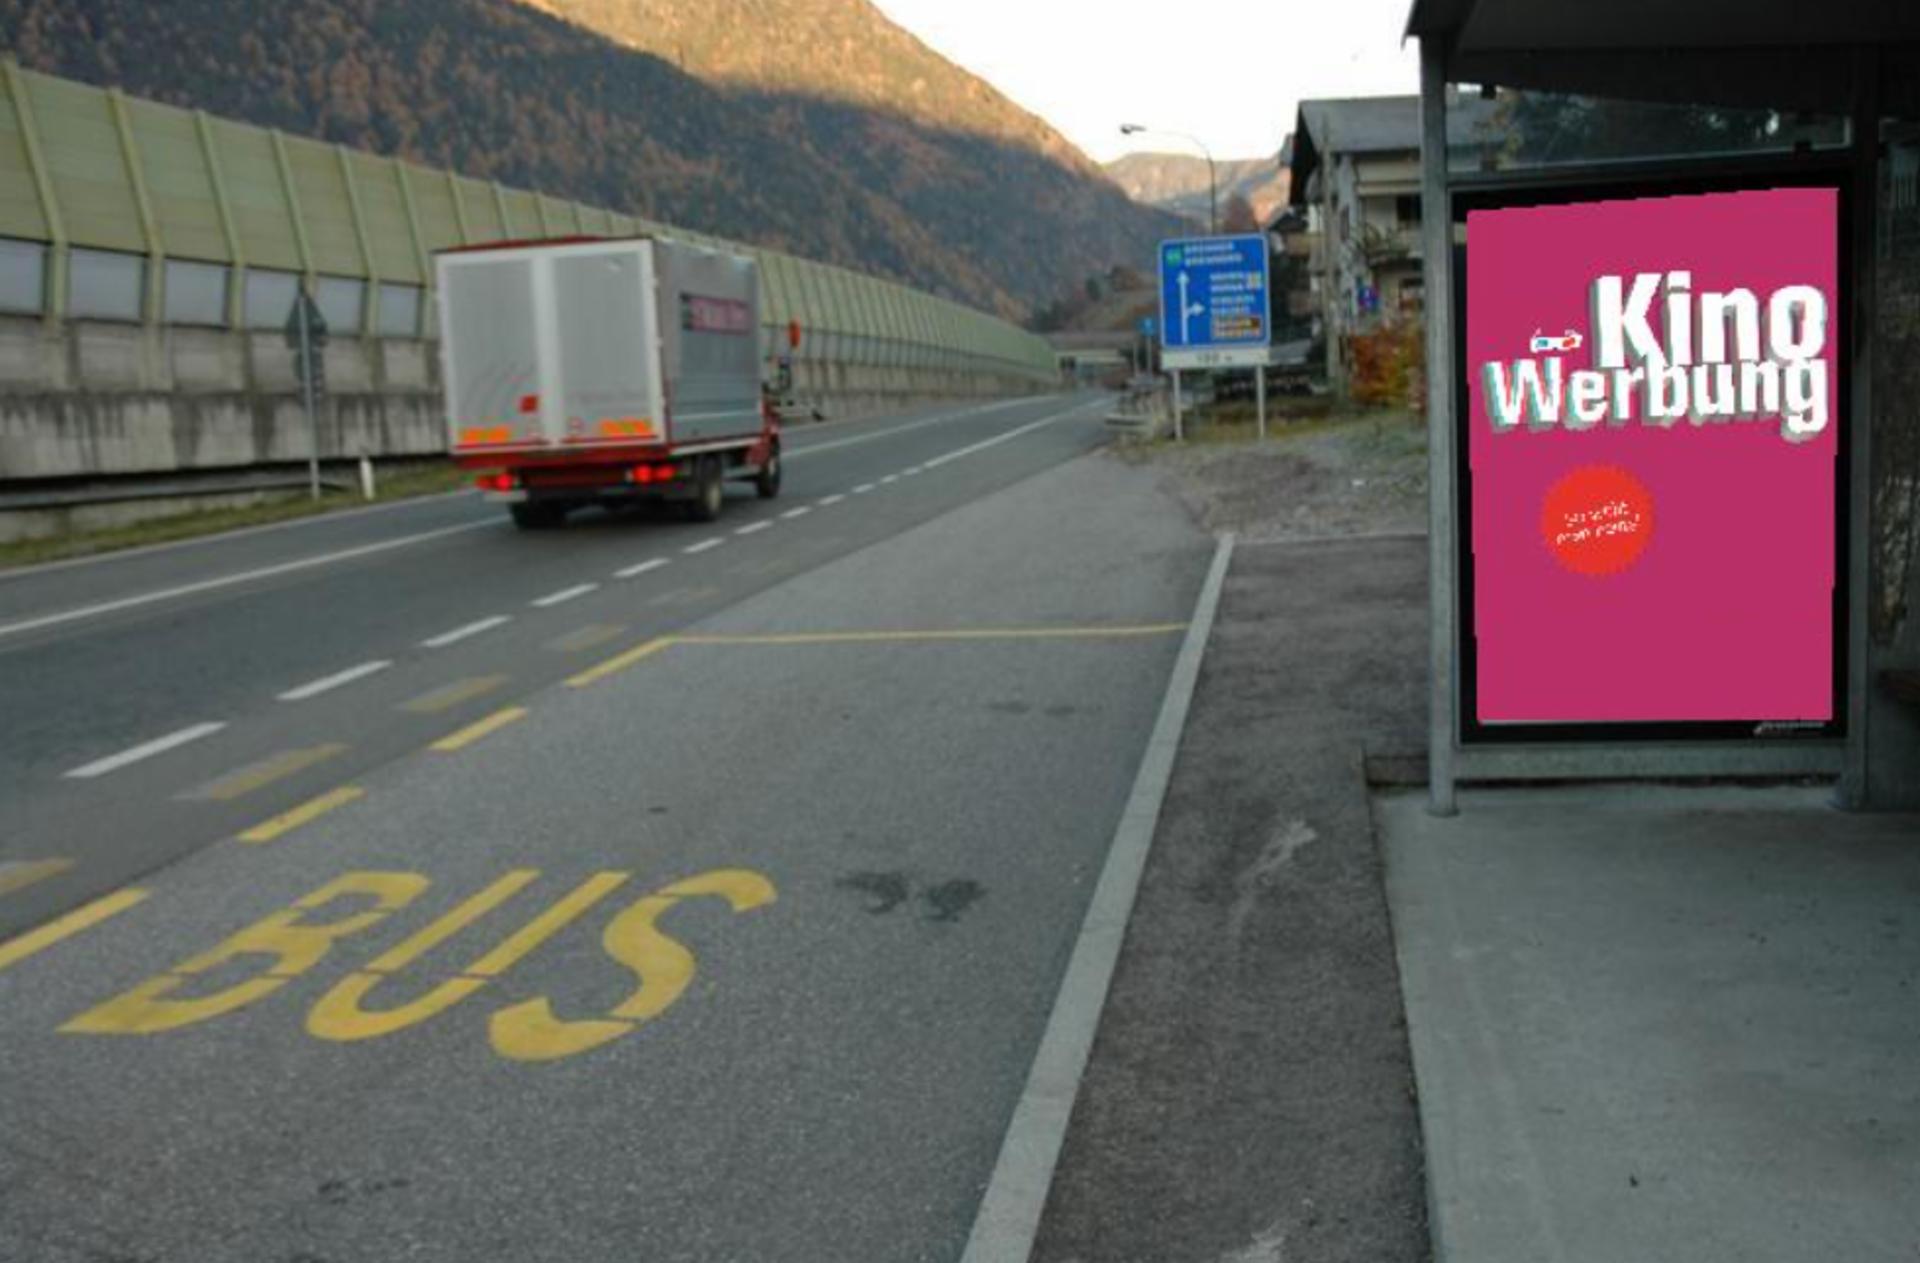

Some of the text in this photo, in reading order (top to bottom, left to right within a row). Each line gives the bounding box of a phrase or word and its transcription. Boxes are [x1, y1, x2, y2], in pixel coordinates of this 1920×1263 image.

[1594, 270, 1827, 368] Kino
[1484, 352, 1828, 437] Werbung
[56, 868, 778, 1062] BUS
